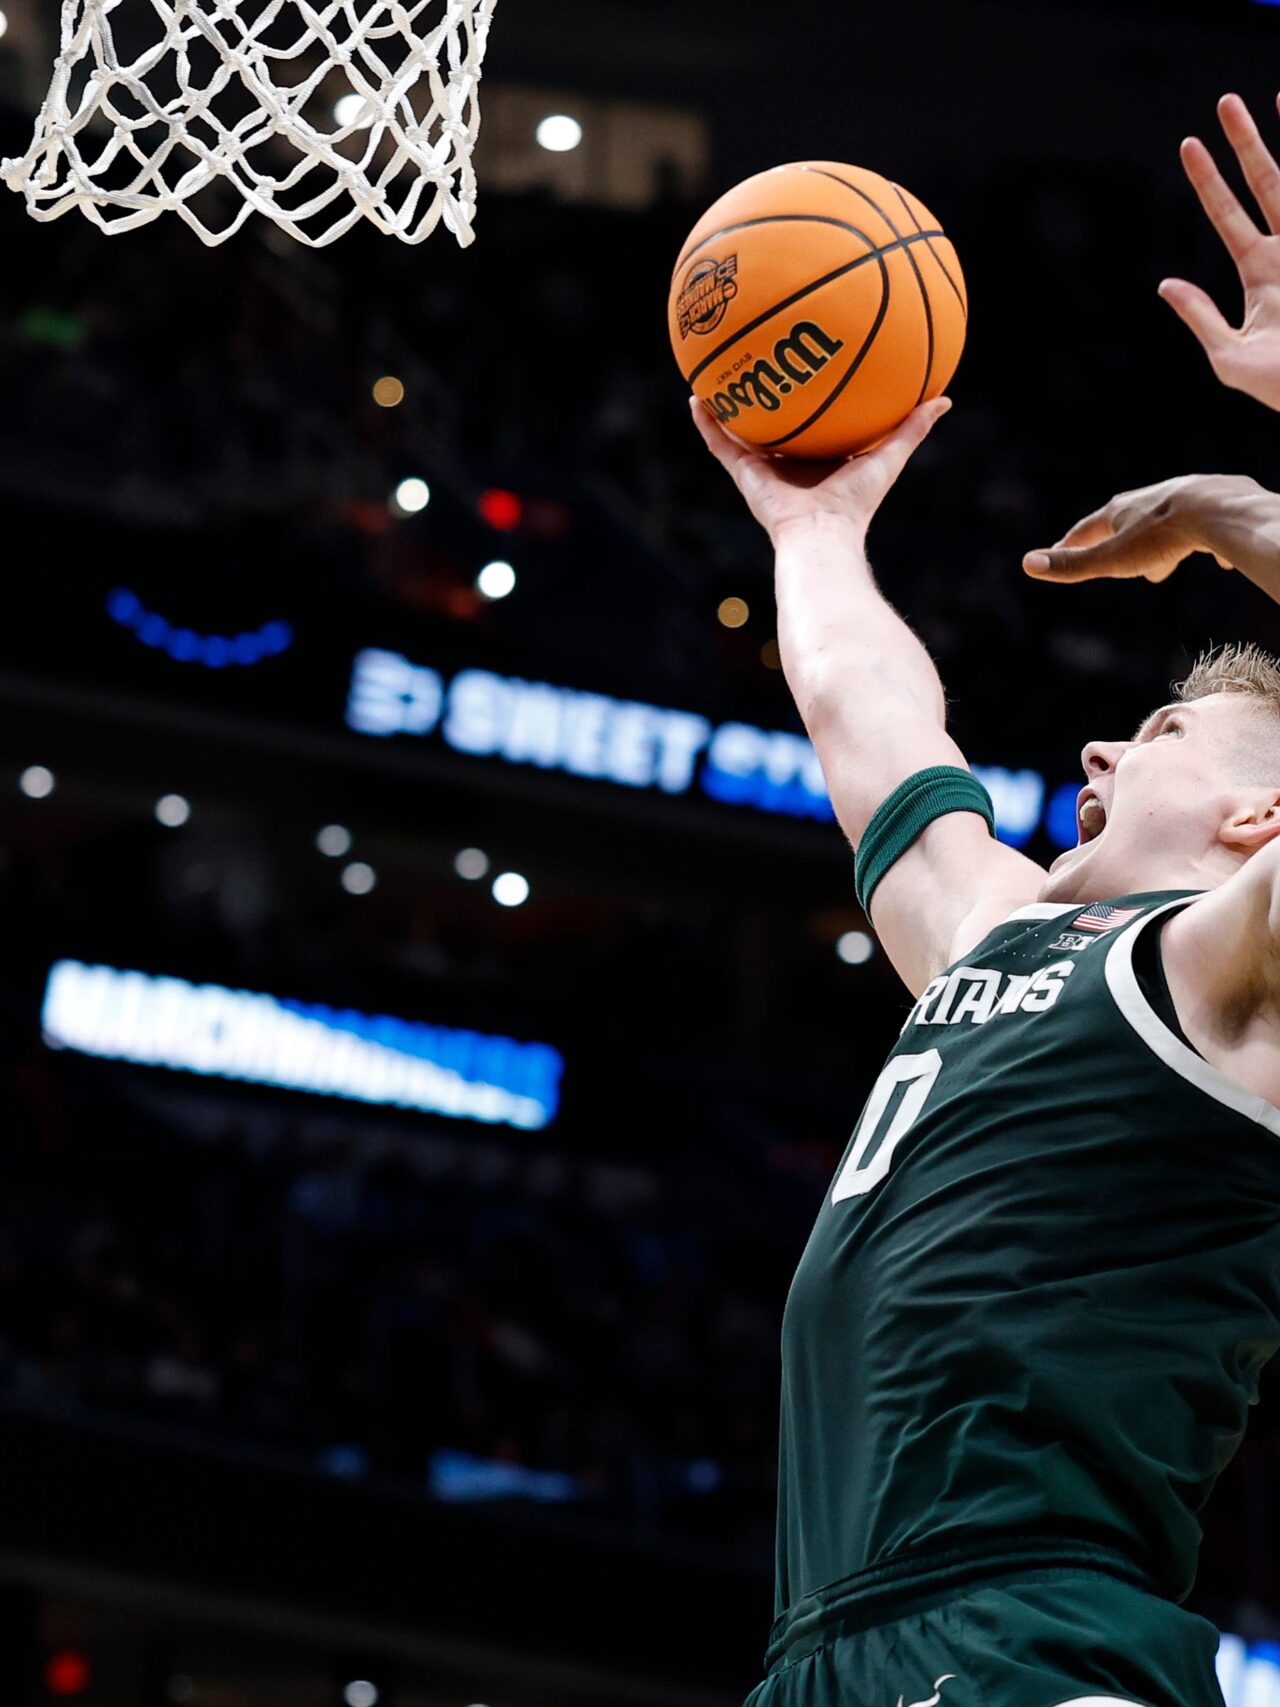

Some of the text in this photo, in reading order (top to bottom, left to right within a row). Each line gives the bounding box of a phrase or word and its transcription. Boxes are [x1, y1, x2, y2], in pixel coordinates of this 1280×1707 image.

[703, 320, 844, 423] Wilson
[733, 352, 753, 371] EVO
[831, 1048, 943, 1207] 0
